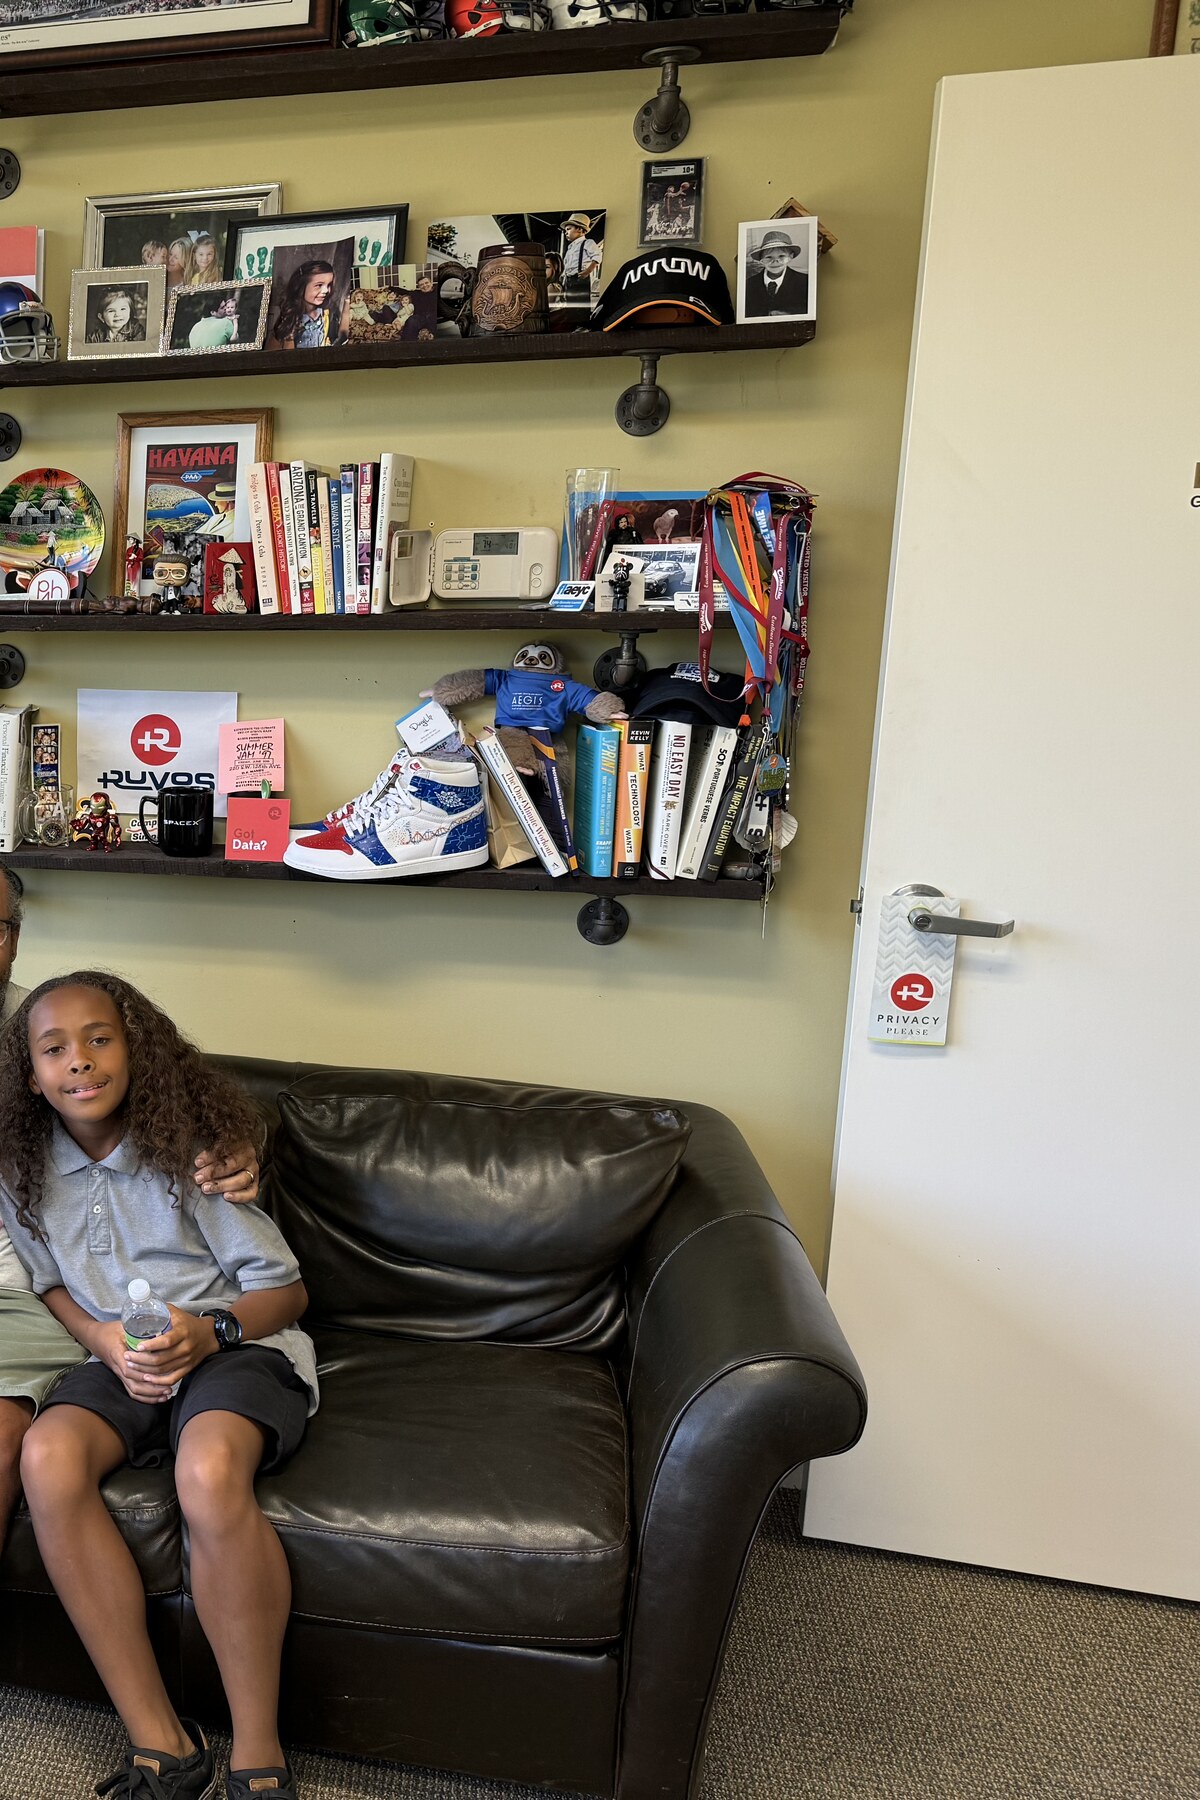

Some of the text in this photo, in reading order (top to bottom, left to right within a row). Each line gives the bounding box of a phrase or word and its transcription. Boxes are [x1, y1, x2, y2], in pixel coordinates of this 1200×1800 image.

[148, 445, 236, 468] HAVANA
[250, 474, 260, 493] Bridges
[254, 500, 262, 514] Cuba
[271, 495, 280, 524] CUBA
[286, 514, 291, 522] DE
[292, 466, 308, 559] ARIZONA GRAND CANYON
[256, 520, 264, 539] Puentes
[331, 500, 340, 549] HAVANA STYLE
[343, 497, 352, 542] VIETNAM
[276, 529, 284, 548] SHORT
[323, 516, 331, 562] PORTUGUESE
[754, 509, 775, 554] LIFE TIME
[258, 546, 266, 558] Cuba
[278, 549, 286, 572] HISTORY
[557, 584, 590, 598] flaeyc
[512, 695, 543, 705] AEGIS
[2, 720, 10, 746] Personal
[236, 742, 274, 752] SUMMER
[237, 750, 272, 760] JAM '97
[602, 737, 617, 776] SPRINT
[668, 735, 686, 798] NO EASY DAY
[552, 766, 566, 820] PROFESSIONALLY DISTANCED
[700, 748, 728, 823] 501 PORTUGUESE VERBS
[630, 774, 640, 826] TECHNOLOGY
[164, 818, 204, 826] SPACEX
[505, 772, 554, 856] The One Minute Workout
[714, 775, 749, 856] THE IMPACT EQUATION
[232, 839, 267, 850] Data?
[234, 828, 255, 838] Got
[877, 1014, 940, 1024] PRIVACY
[886, 1028, 928, 1036] PLEASE
